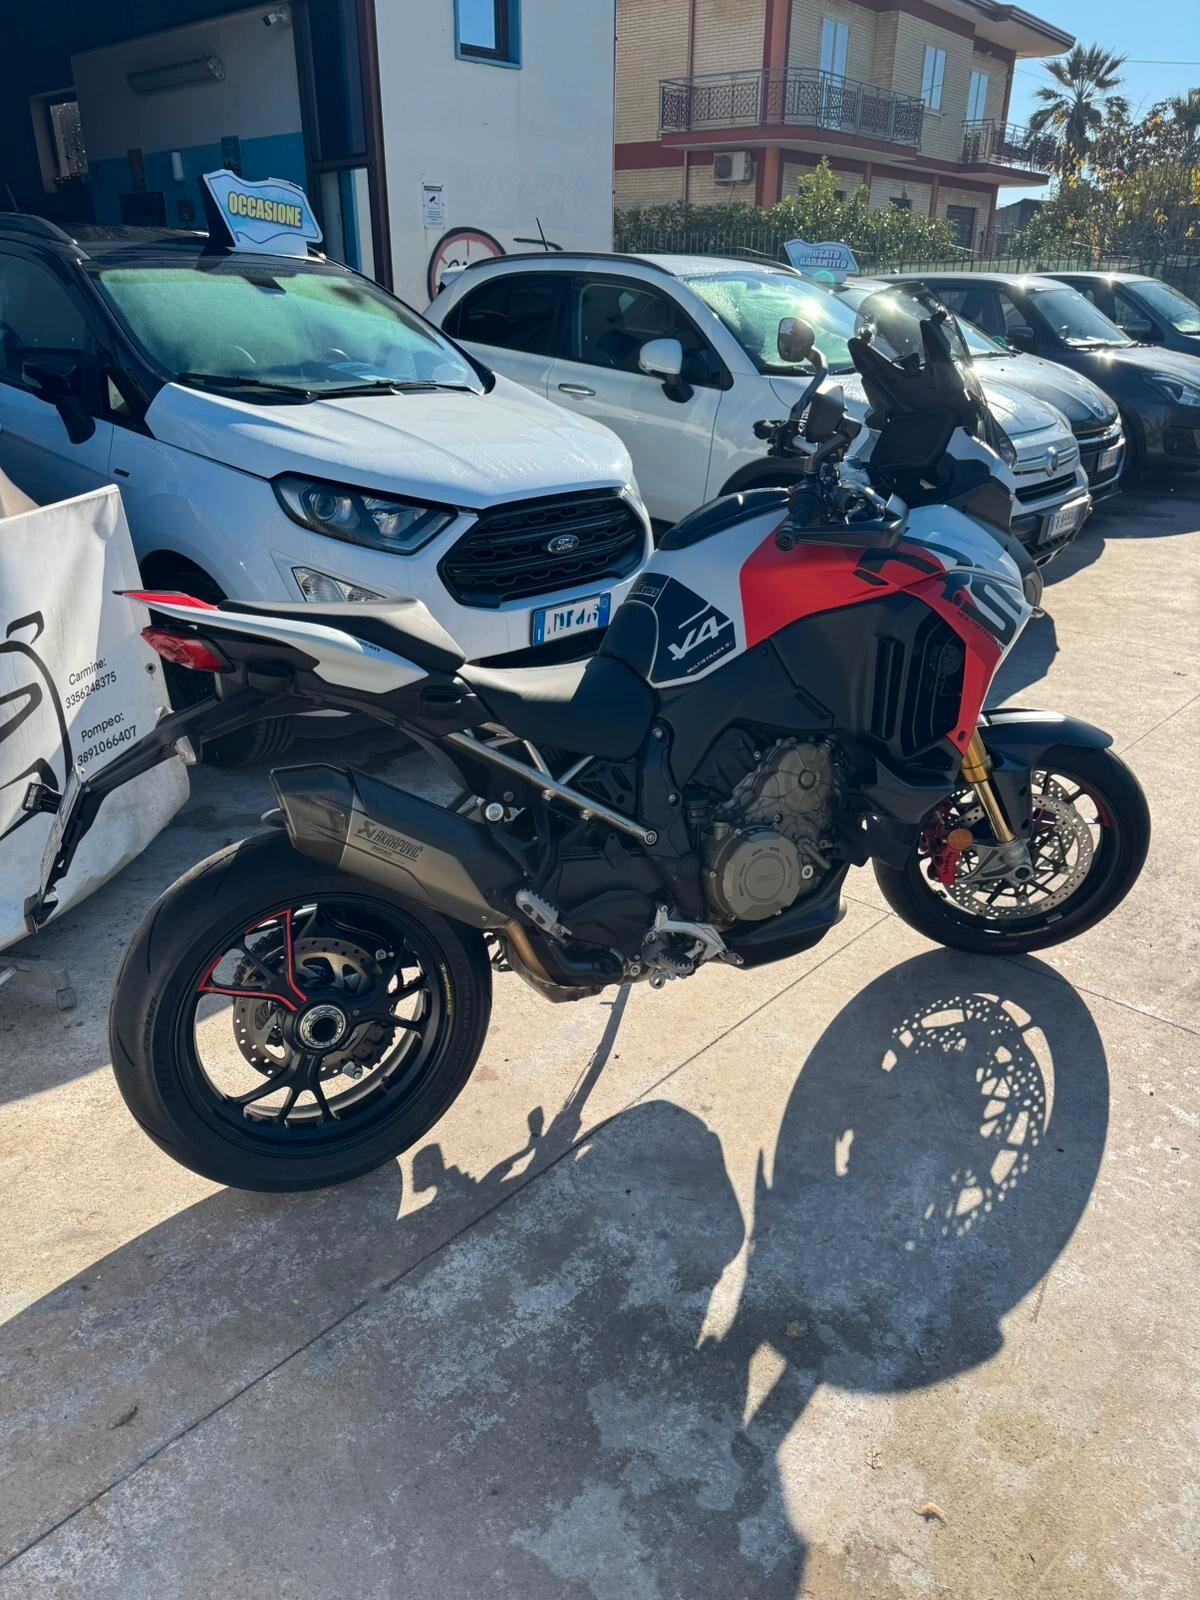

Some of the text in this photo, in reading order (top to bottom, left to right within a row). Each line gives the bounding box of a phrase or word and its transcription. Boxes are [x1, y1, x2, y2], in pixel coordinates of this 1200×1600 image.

[228, 191, 303, 228] OCCASIONE
[800, 257, 848, 268] GARANTITO
[812, 249, 841, 259] USATO
[667, 616, 720, 661] V4
[68, 658, 107, 686] Carmine:
[65, 671, 117, 709] 3356248375
[81, 712, 124, 743] Pompeo:
[77, 725, 137, 766] 3891066407
